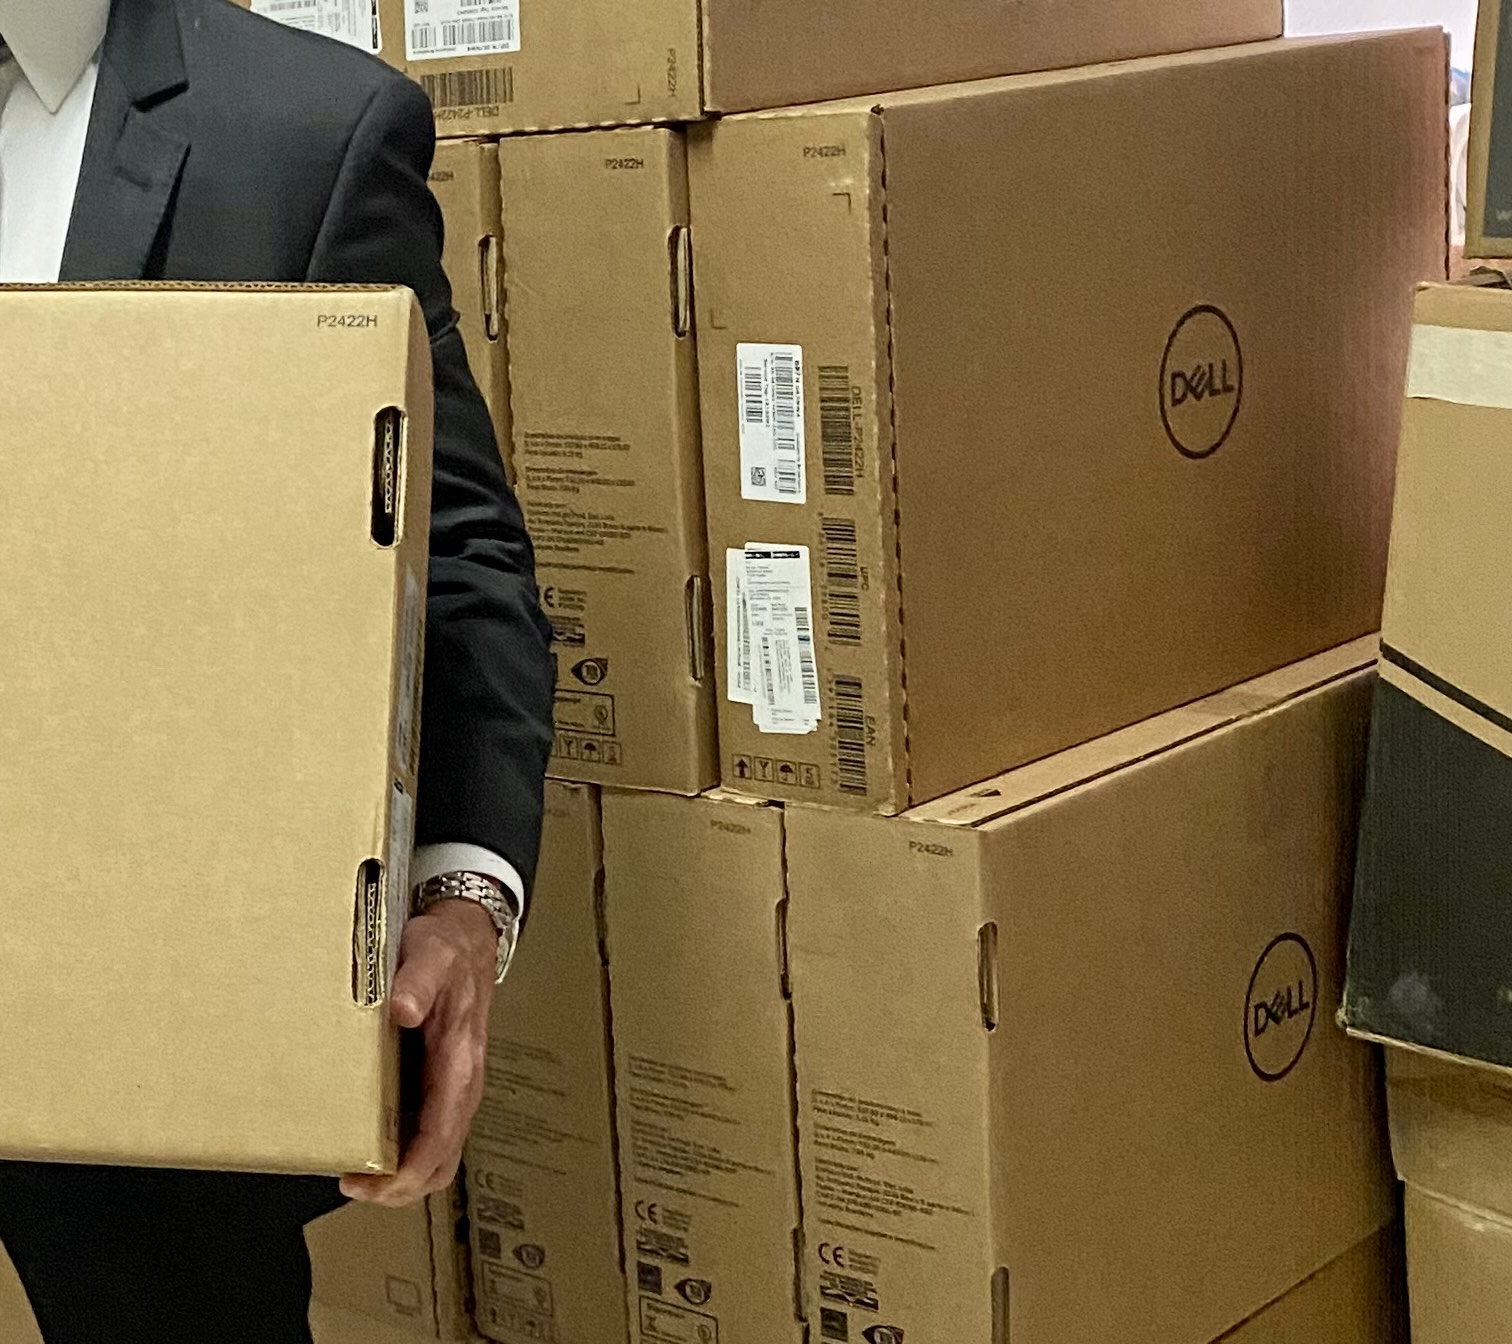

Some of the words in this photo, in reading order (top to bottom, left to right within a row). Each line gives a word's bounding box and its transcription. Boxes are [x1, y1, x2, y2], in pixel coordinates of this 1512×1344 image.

[605, 158, 644, 169] P2422H
[802, 145, 846, 157] P2422H
[430, 170, 454, 181] 422H
[317, 315, 378, 327] P2422H
[1171, 359, 1235, 407] DELL
[851, 385, 865, 478] DELL-P2422H
[860, 566, 870, 591] UPC
[864, 716, 876, 747] EAN
[908, 840, 953, 857] P2422H
[1254, 979, 1310, 1038] DELL
[817, 1242, 845, 1269] CE
